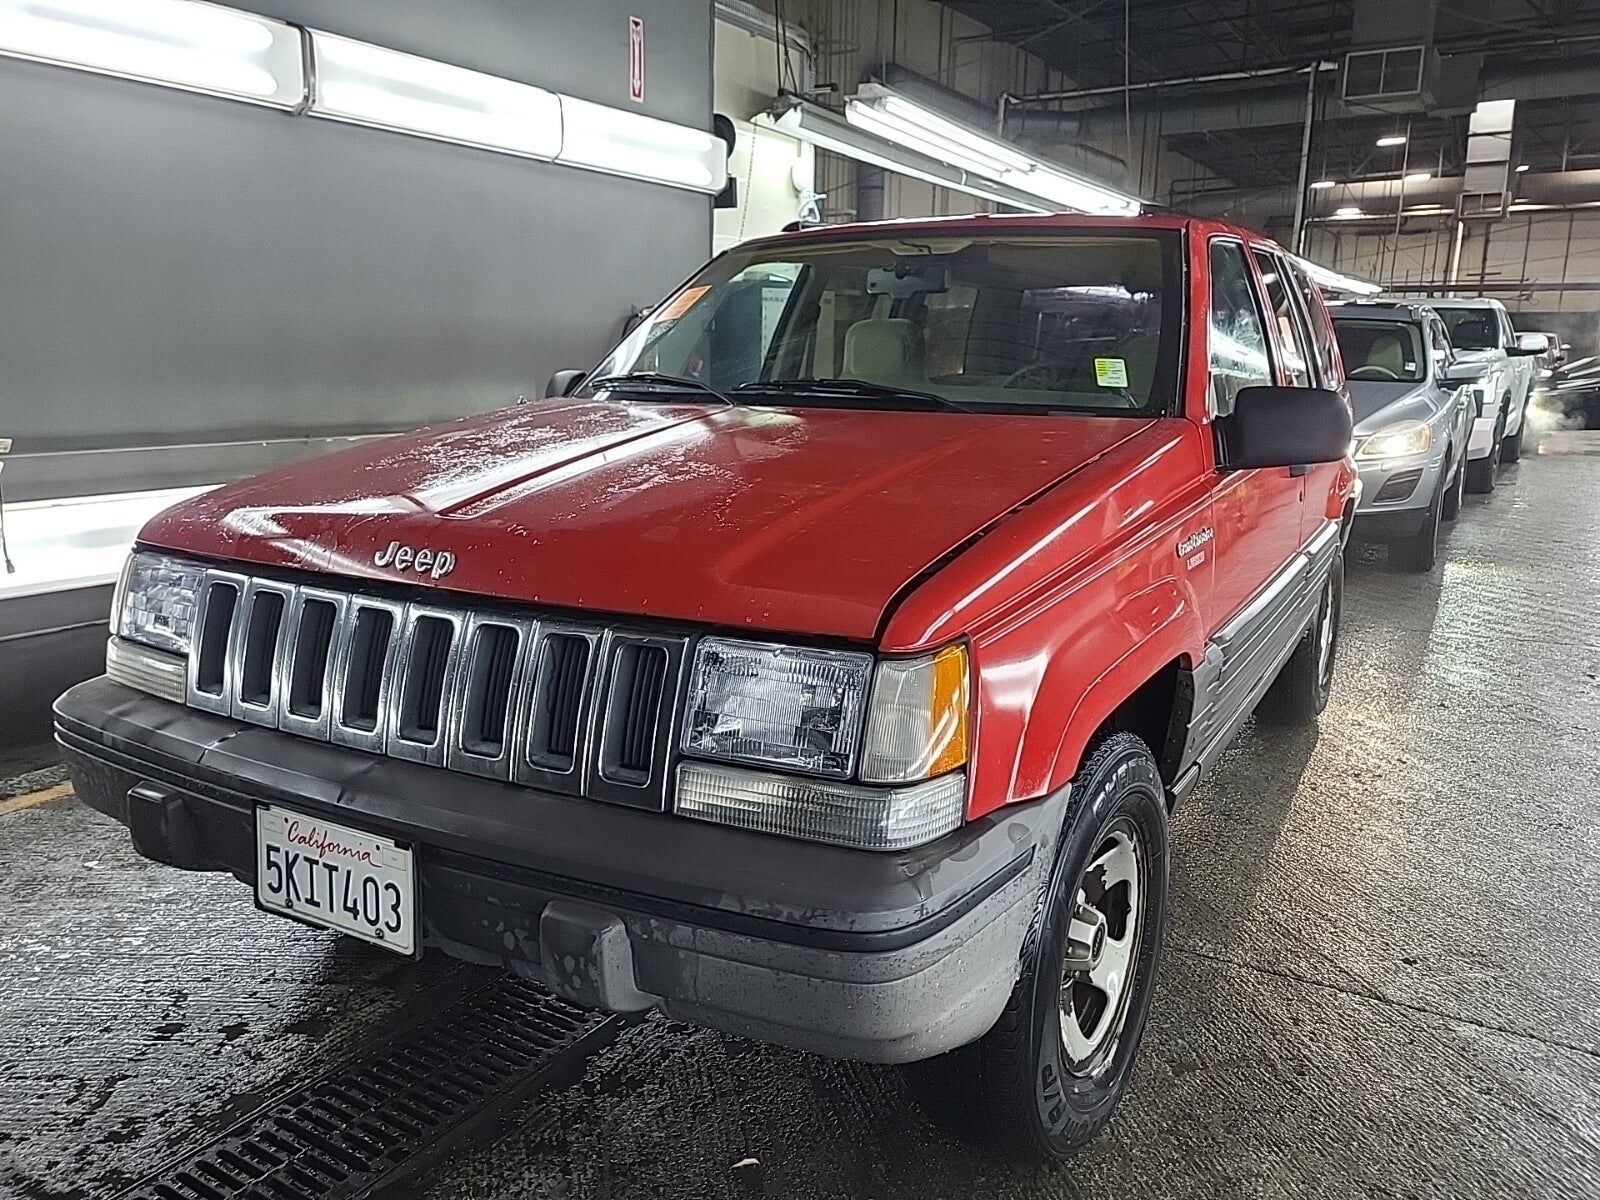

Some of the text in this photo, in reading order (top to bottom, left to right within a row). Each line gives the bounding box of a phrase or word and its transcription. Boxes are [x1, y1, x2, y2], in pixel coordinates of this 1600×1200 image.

[374, 541, 456, 580] Jeep
[288, 820, 382, 868] California
[266, 844, 402, 933] 5KIT403
